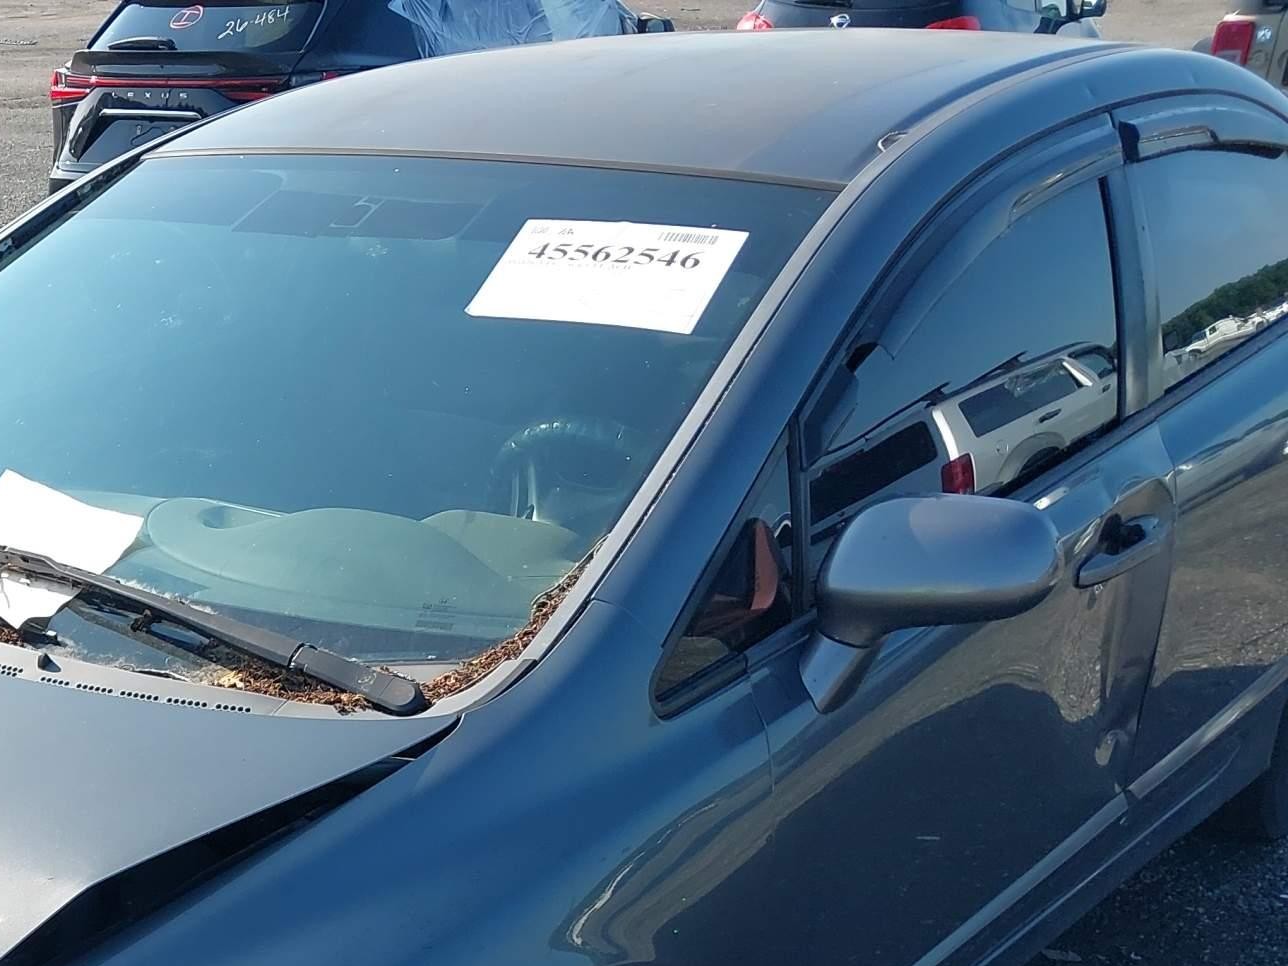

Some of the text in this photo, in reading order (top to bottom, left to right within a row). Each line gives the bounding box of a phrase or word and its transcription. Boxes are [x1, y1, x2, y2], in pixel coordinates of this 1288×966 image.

[217, 5, 290, 40] 26-484
[111, 91, 189, 99] LEXUS
[527, 242, 704, 270] 45562546
